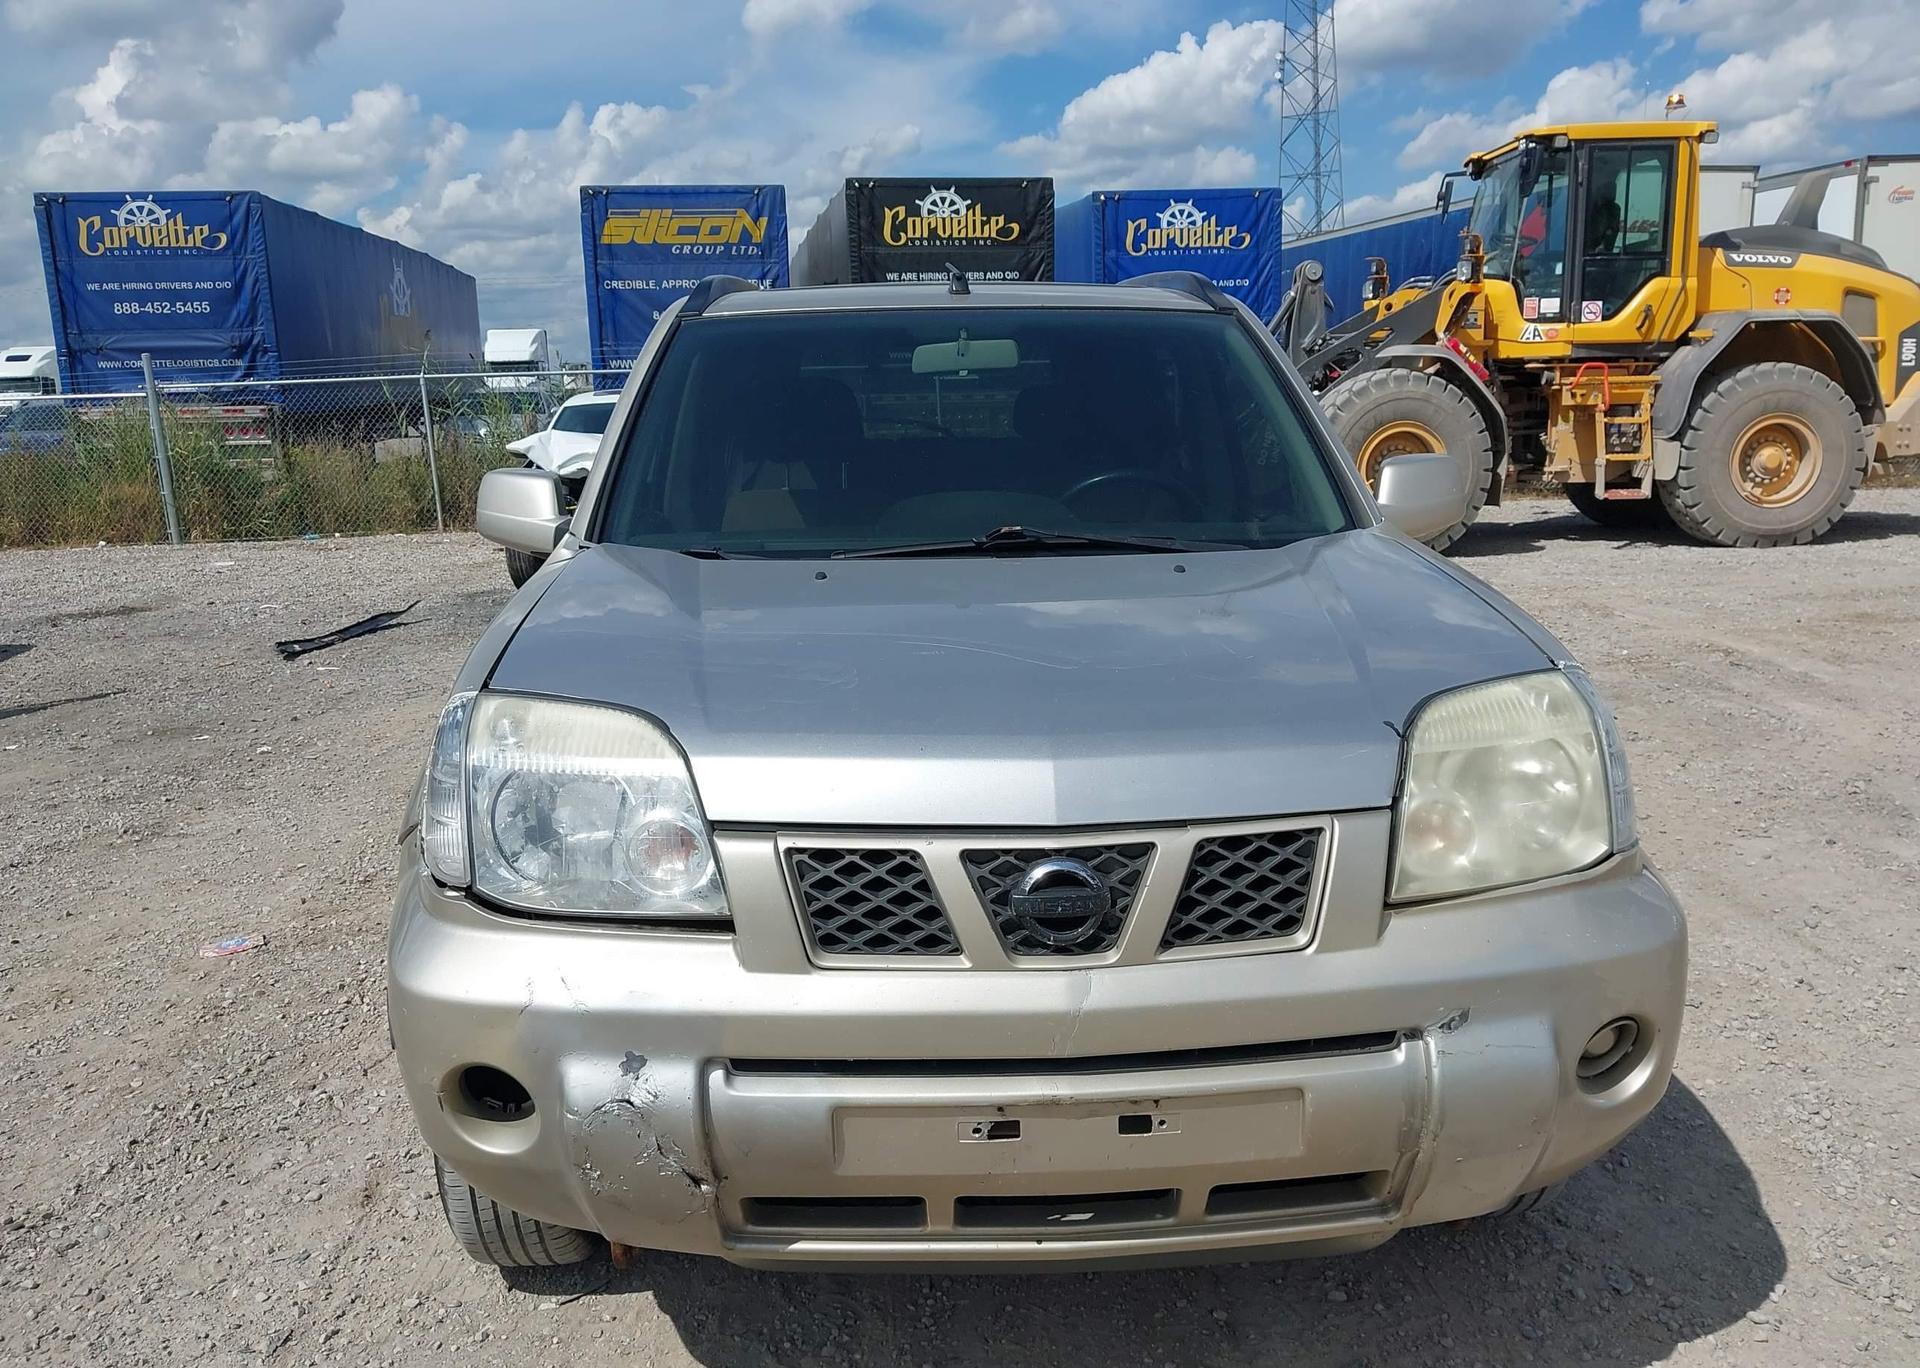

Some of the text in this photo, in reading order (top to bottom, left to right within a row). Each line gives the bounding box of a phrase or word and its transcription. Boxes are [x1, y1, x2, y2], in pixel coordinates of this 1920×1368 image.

[883, 203, 1020, 246] Corvette
[78, 212, 228, 256] Corvette
[1125, 215, 1250, 256] Corvette
[672, 245, 762, 255] GROUP LTD.
[1729, 253, 1793, 264] VOLVO
[886, 272, 900, 281] WE
[901, 272, 918, 281] ARE
[919, 272, 948, 281] HIRING
[949, 271, 985, 280] DVERS
[986, 271, 1004, 280] AND
[86, 282, 102, 291] WE
[102, 282, 121, 291] ARE
[122, 282, 153, 290] HIRING
[155, 282, 193, 290] DRIVERS
[195, 281, 214, 290] AND
[604, 280, 660, 290] CREDIBLE,
[662, 280, 700, 289] APPRO
[1218, 279, 1235, 287] AND
[114, 302, 211, 315] 888-452-5455
[1901, 338, 1917, 366] L90H
[97, 359, 243, 369] WWW.CORETTELOGISTICS.COM
